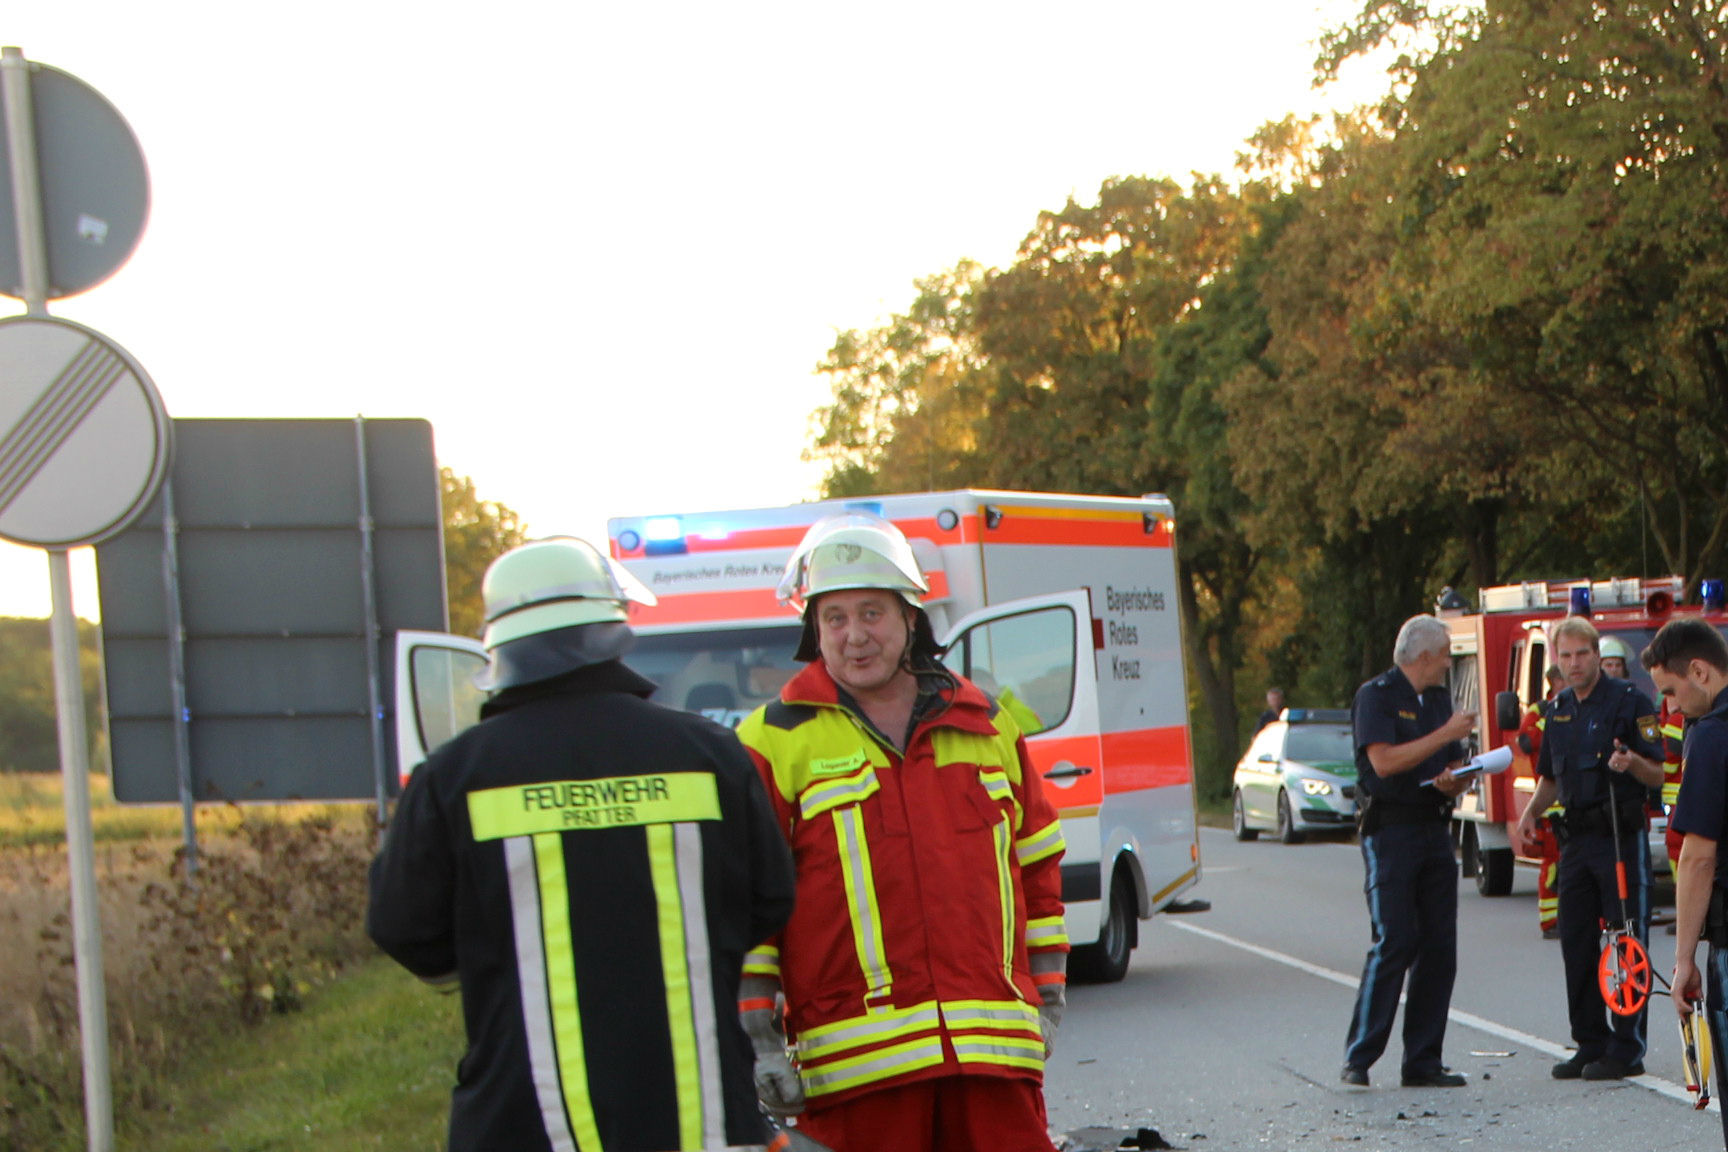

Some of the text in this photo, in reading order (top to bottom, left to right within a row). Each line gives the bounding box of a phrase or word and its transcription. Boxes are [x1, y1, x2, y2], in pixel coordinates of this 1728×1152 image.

[1107, 585, 1165, 616] Bayerisches
[1109, 620, 1138, 645] Rotes
[1112, 655, 1140, 679] Kreuz
[524, 778, 669, 810] FEUERWEHR
[563, 807, 636, 825] PFATTER
